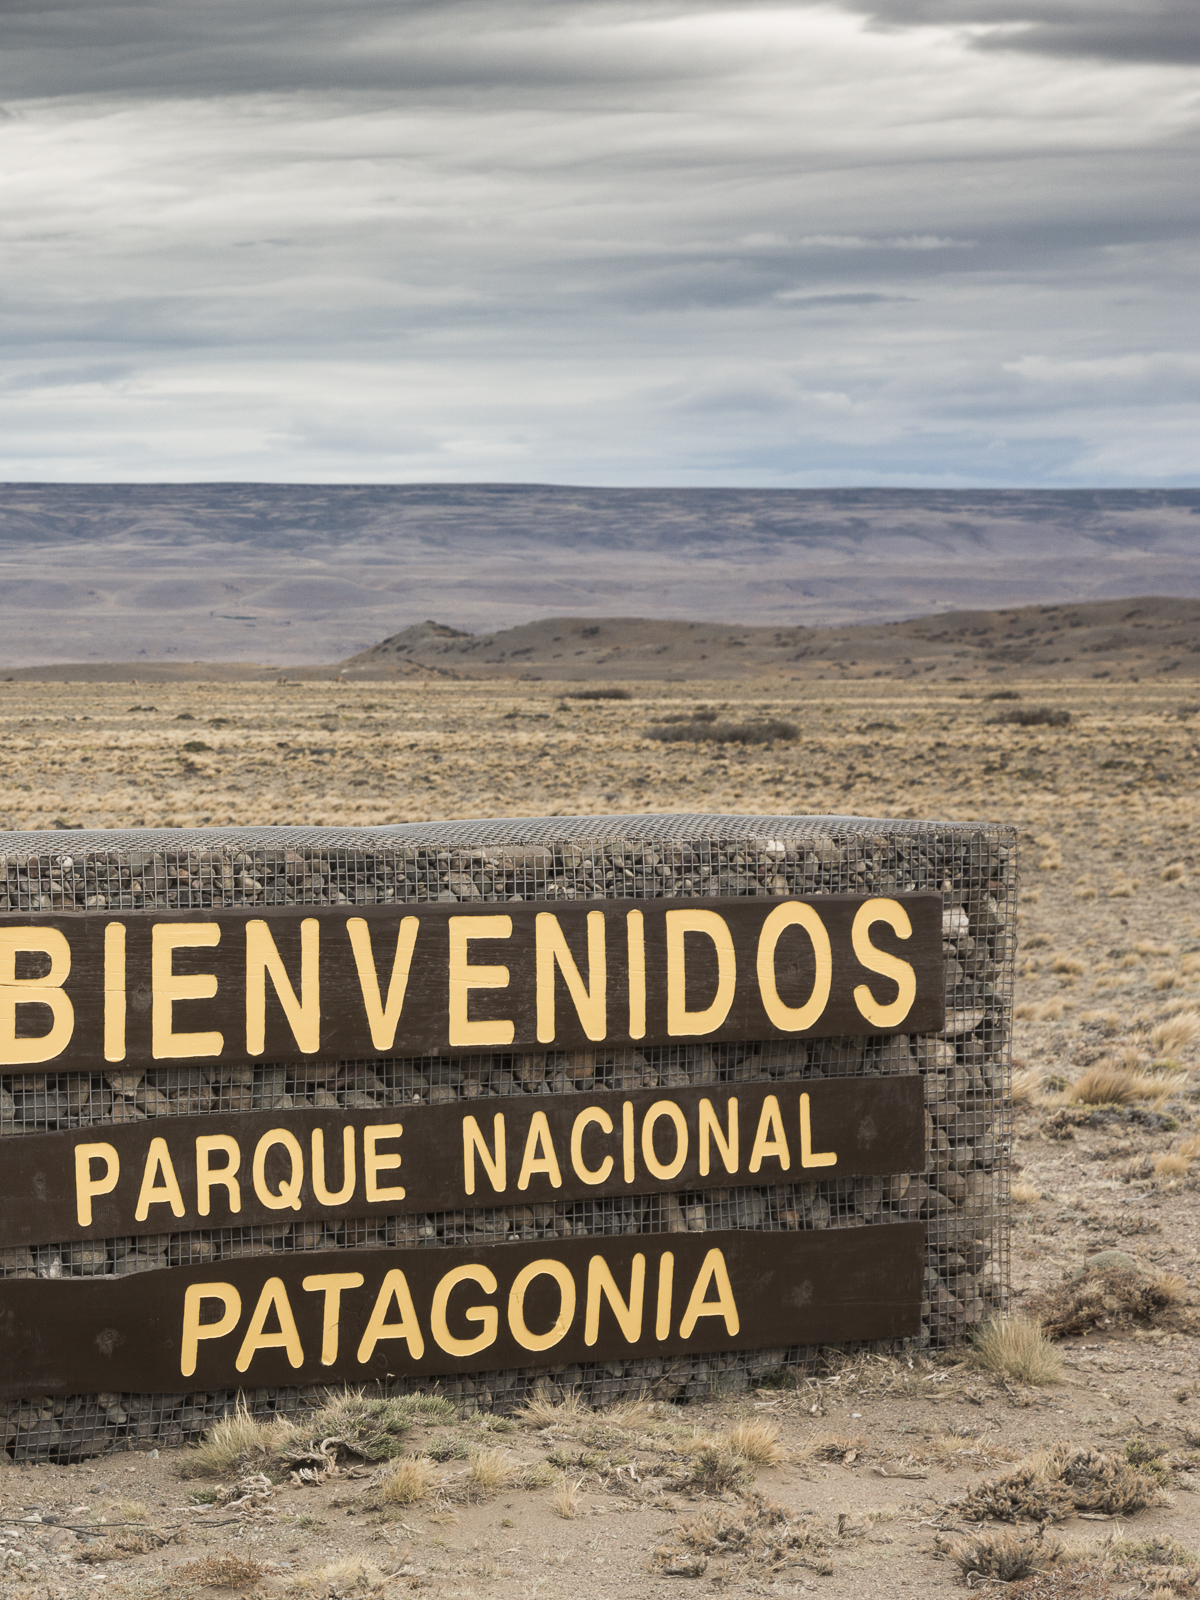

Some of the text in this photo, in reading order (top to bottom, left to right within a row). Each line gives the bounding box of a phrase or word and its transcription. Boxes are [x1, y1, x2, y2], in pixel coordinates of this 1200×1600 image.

[74, 1092, 838, 1227] PARQUE NACIONAL
[180, 1247, 740, 1377] PATAGONIA
